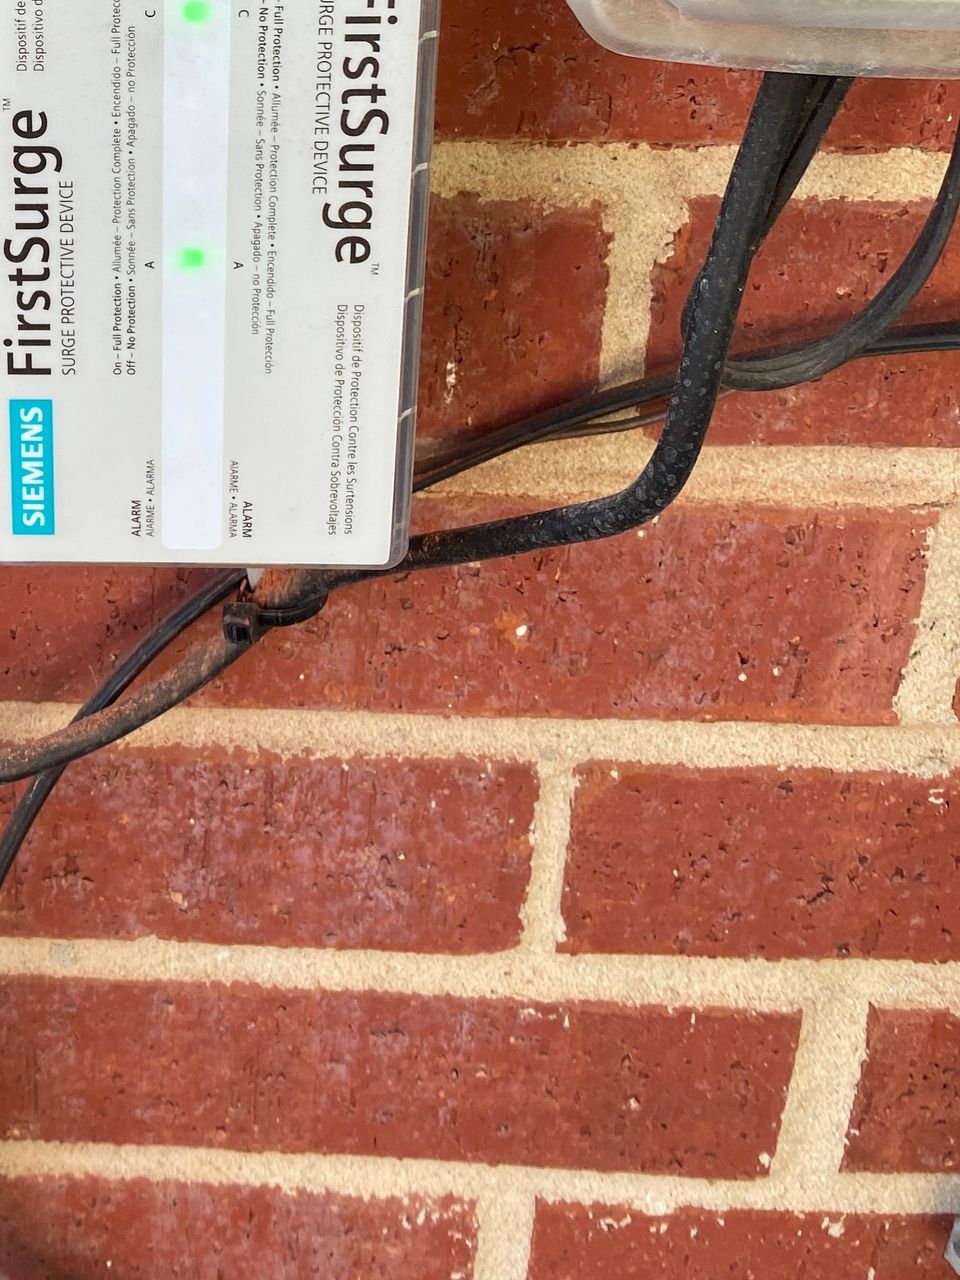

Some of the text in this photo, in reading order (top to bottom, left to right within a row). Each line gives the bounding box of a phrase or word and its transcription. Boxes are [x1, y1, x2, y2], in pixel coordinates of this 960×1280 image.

[14, 0, 26, 15] de
[144, 9, 156, 17] C
[238, 9, 249, 17] C
[258, 7, 268, 22] No
[273, 5, 284, 24] Full
[14, 18, 29, 71] Dispositif
[31, 9, 47, 71] Dispositivo
[110, 36, 120, 54] Full
[257, 25, 268, 78] Protection
[272, 27, 283, 81] Protection
[111, 66, 121, 117] Encendido
[255, 90, 266, 126] Sonnée
[314, 41, 332, 134] PROTECTIVE
[270, 92, 281, 132] Allumée
[111, 128, 123, 173] Complete
[255, 138, 265, 160] Sans
[268, 144, 279, 192] Protection
[312, 140, 328, 194] DEVICE
[111, 176, 121, 223] Protection
[125, 25, 138, 375] Off No Protection Sonnée Sans Protection Apagado no Protección
[254, 163, 264, 210] Protection
[266, 195, 278, 240] Complete
[112, 234, 121, 272] Allumée
[250, 221, 262, 262] Apagado
[58, 180, 75, 375] SURGE PROTECTIVE DEVICE
[144, 260, 154, 269] A
[233, 261, 243, 269] A
[252, 273, 259, 285] no
[266, 250, 277, 298] Encendido
[111, 283, 121, 331] Protection
[251, 288, 261, 334] Protección
[265, 309, 275, 325] Full
[112, 334, 121, 350] Full
[264, 327, 274, 373] Protección
[112, 361, 122, 375] On
[326, 304, 348, 535] Dispositivo de Protección Contra Sobrevoltajes
[343, 304, 365, 534] Dispositif de Protection Contre les Surtensions
[20, 407, 44, 526] SIEMENS
[145, 459, 154, 495] ALARMA
[130, 500, 141, 536] ALARM
[228, 502, 237, 537] ALARMA
[242, 500, 252, 537] ALARM
